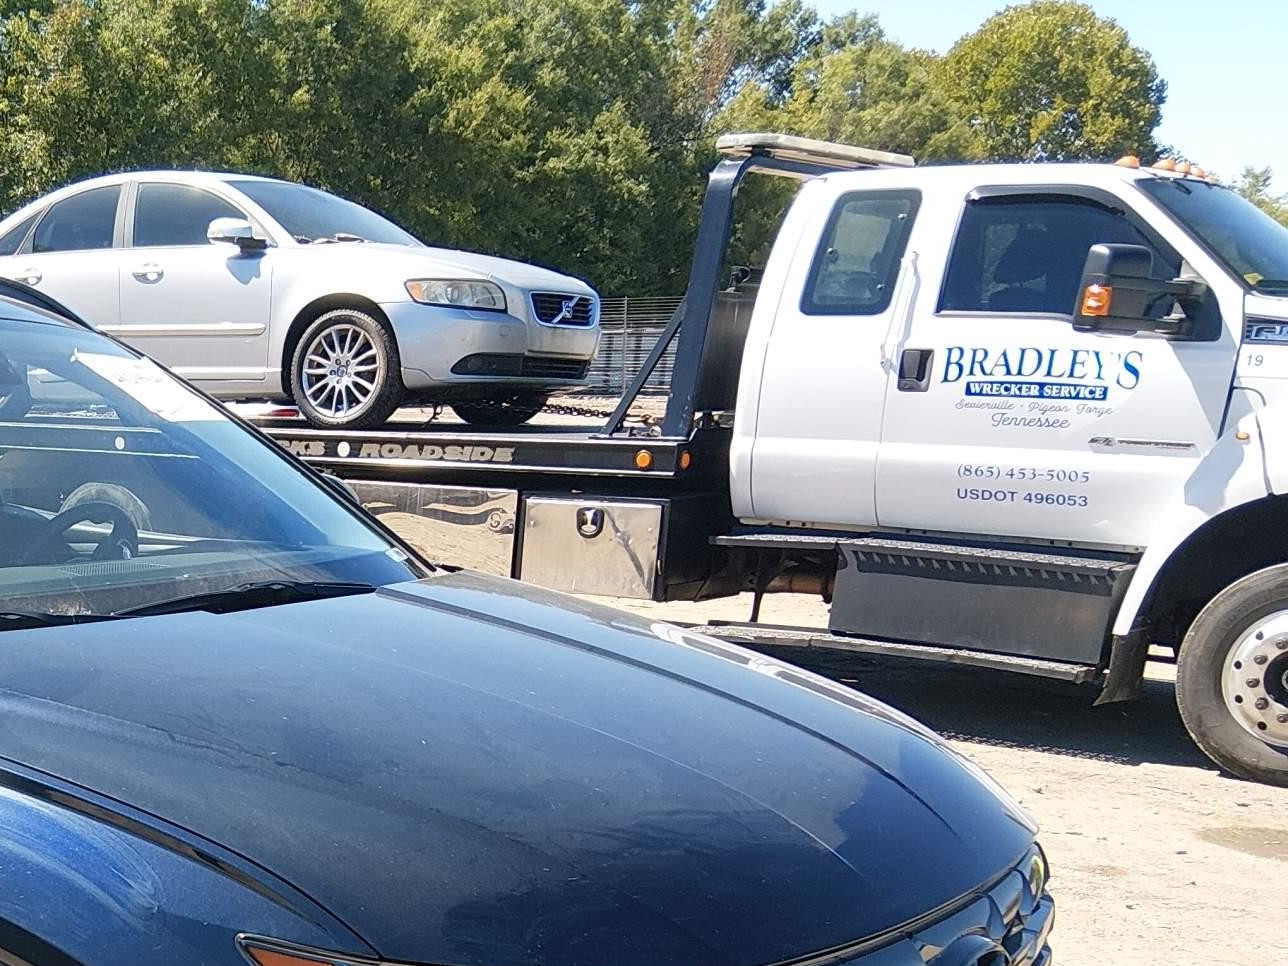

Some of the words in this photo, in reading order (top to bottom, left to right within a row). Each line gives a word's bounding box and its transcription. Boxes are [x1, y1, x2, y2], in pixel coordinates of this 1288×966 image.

[940, 345, 1143, 389] BRADLEY'S
[1246, 354, 1264, 367] 19
[969, 382, 1039, 397] WRECKER
[1043, 384, 1105, 399] SERVICE
[1028, 401, 1071, 415] Pigeon
[1075, 403, 1114, 417] Forge
[991, 412, 1072, 429] Tennessee
[360, 443, 515, 462] ROADSIDE
[957, 464, 1001, 480] (865)
[1005, 467, 1090, 484] 453-5005
[956, 487, 1018, 502] USDOT
[1023, 491, 1089, 507] 496053
